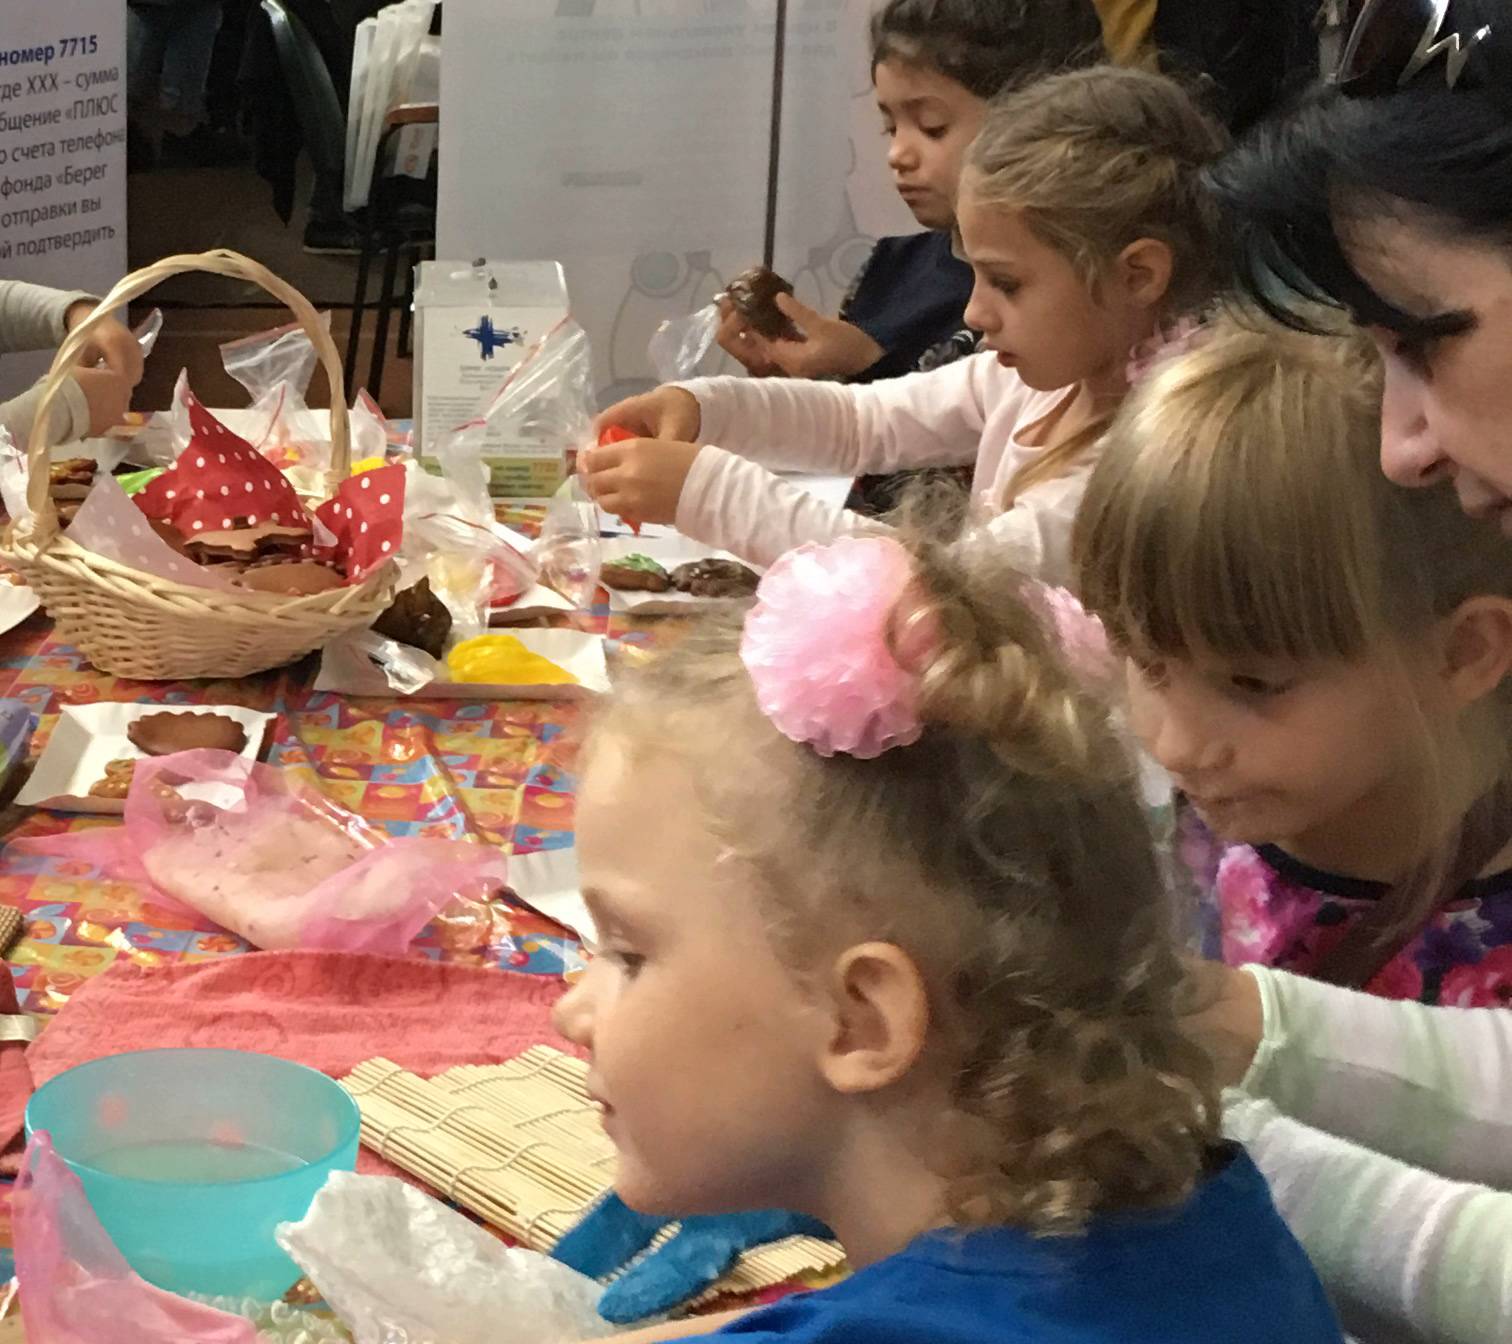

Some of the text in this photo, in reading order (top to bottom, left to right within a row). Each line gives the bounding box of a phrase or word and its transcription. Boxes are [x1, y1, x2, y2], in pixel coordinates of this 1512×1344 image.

[59, 35, 97, 58] 7715
[75, 66, 119, 89] сумма
[65, 94, 118, 120] «ПЛЮС
[12, 142, 55, 163] счета
[0, 175, 52, 200] фонда
[56, 163, 108, 187] «Берег
[2, 201, 77, 229] отправки
[81, 197, 101, 213] вы
[17, 225, 115, 256] подтвердить
